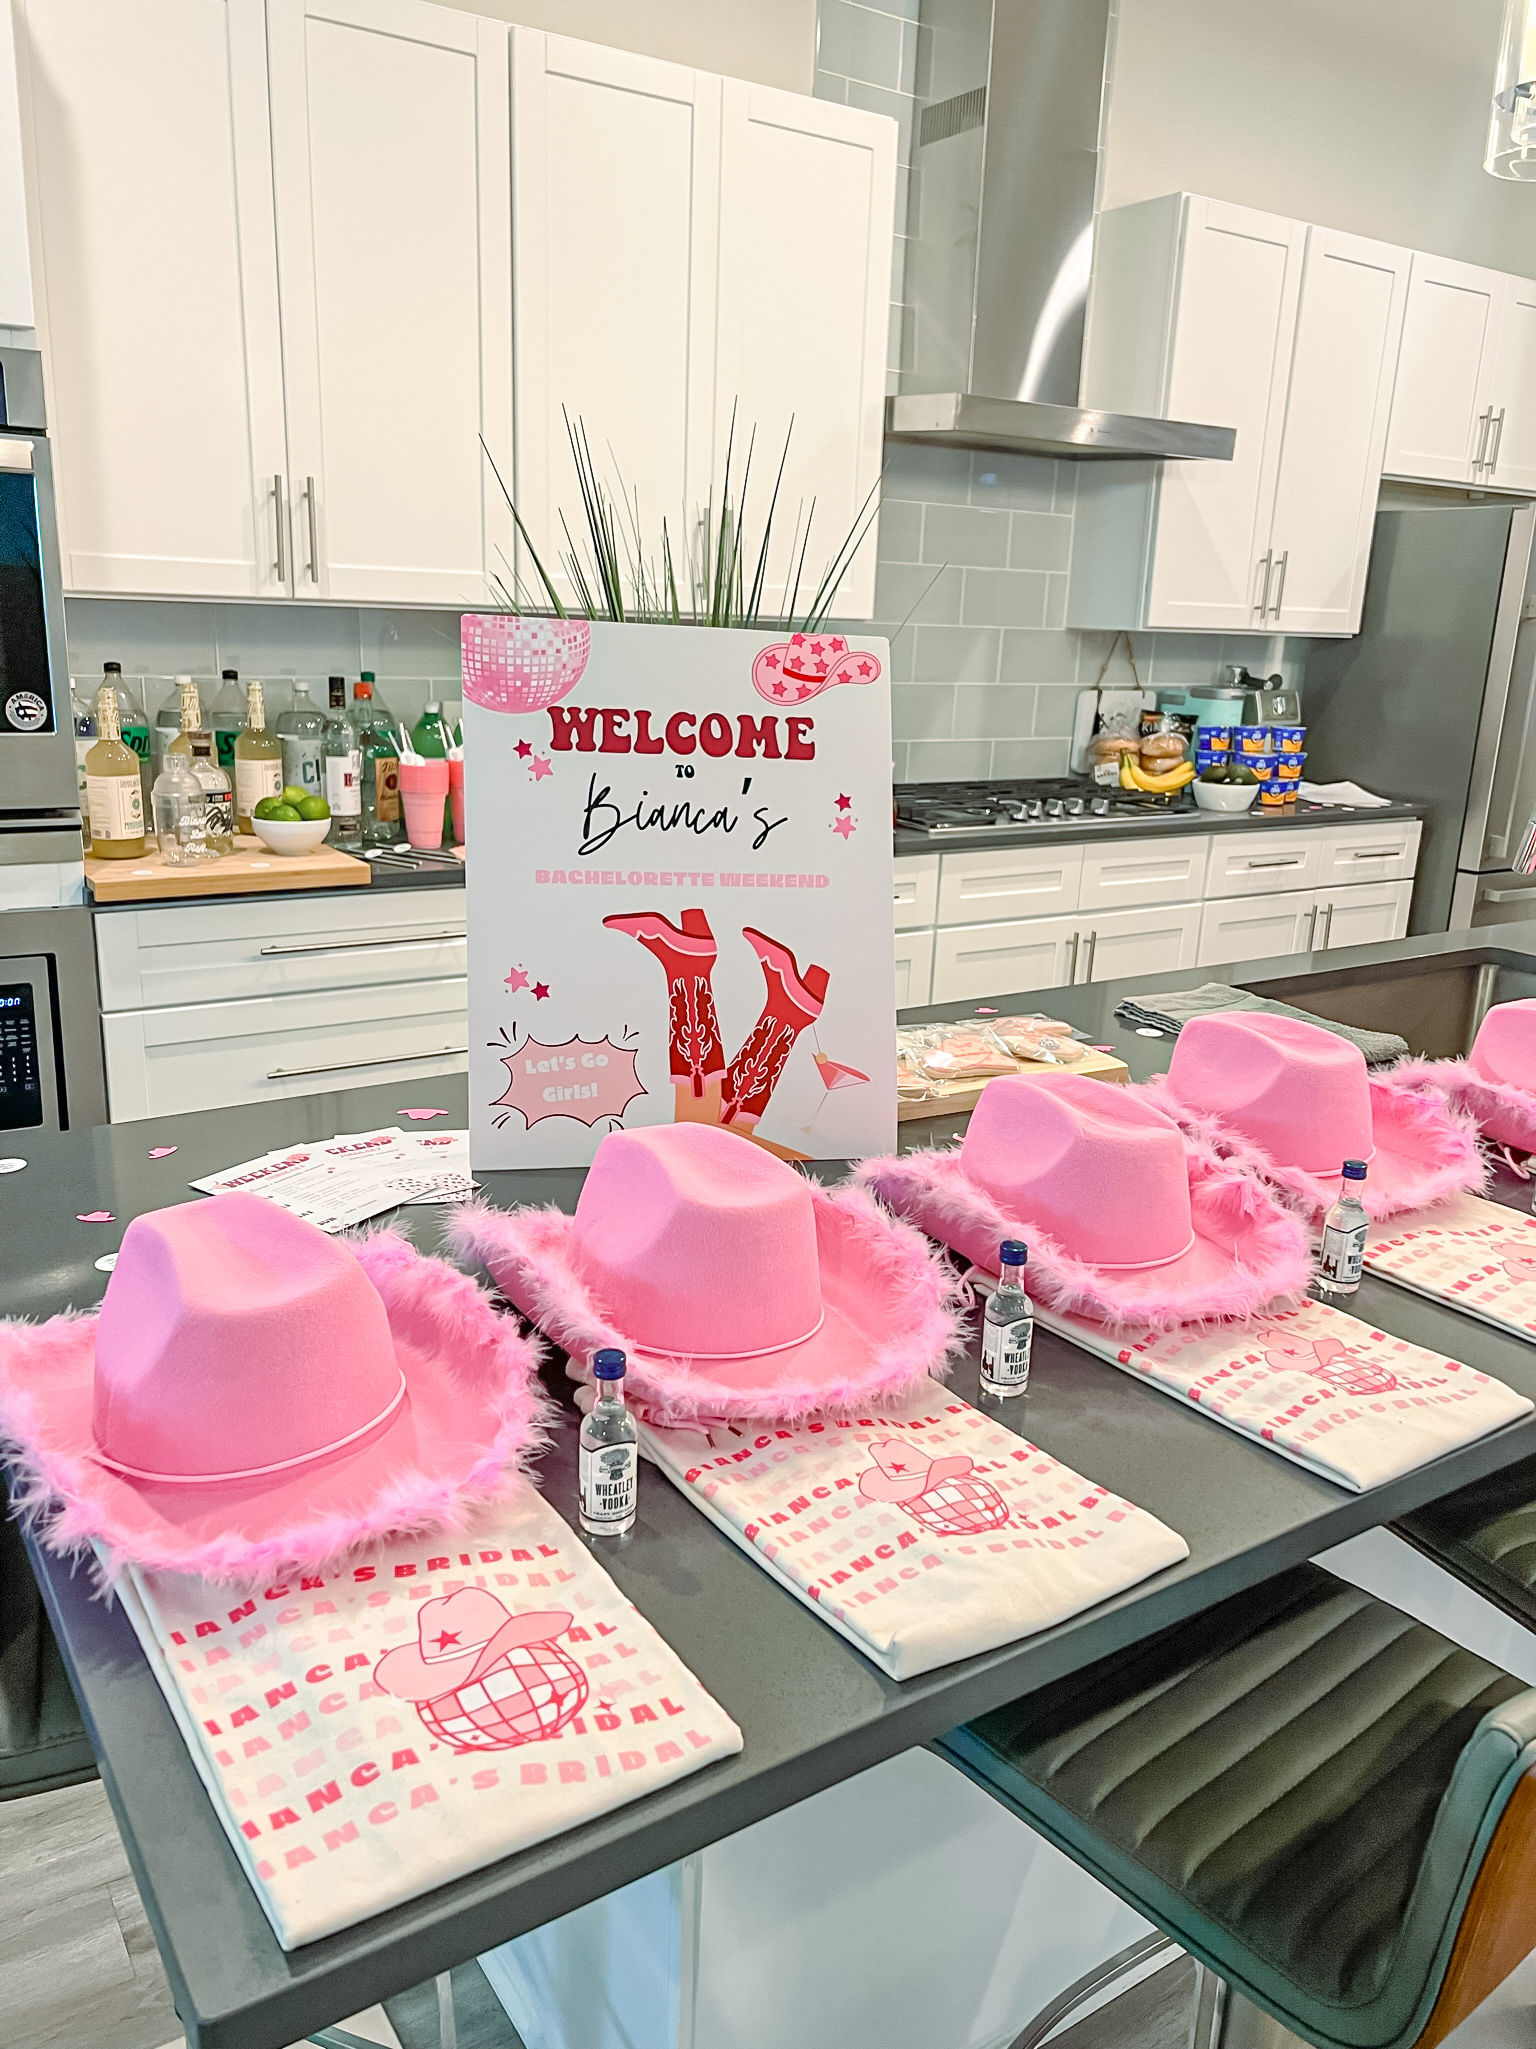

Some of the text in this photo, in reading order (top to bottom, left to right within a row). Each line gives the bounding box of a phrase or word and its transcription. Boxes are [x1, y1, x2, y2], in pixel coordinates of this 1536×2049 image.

[11, 694, 44, 711] AMERICA
[547, 706, 816, 760] WELCOME
[675, 764, 695, 778] TO
[578, 772, 788, 856] Bianca's
[535, 869, 830, 888] BACHELORETTE WEEKEND
[525, 1052, 609, 1074] Let's Go
[543, 1082, 598, 1102] Girls!
[685, 1422, 825, 1484] BIANCA'S
[595, 1476, 634, 1496] WHEATLEY
[602, 1493, 629, 1510] VODKA
[394, 1544, 559, 1578] BRIDAL
[520, 1729, 713, 1786] BRIDAL
